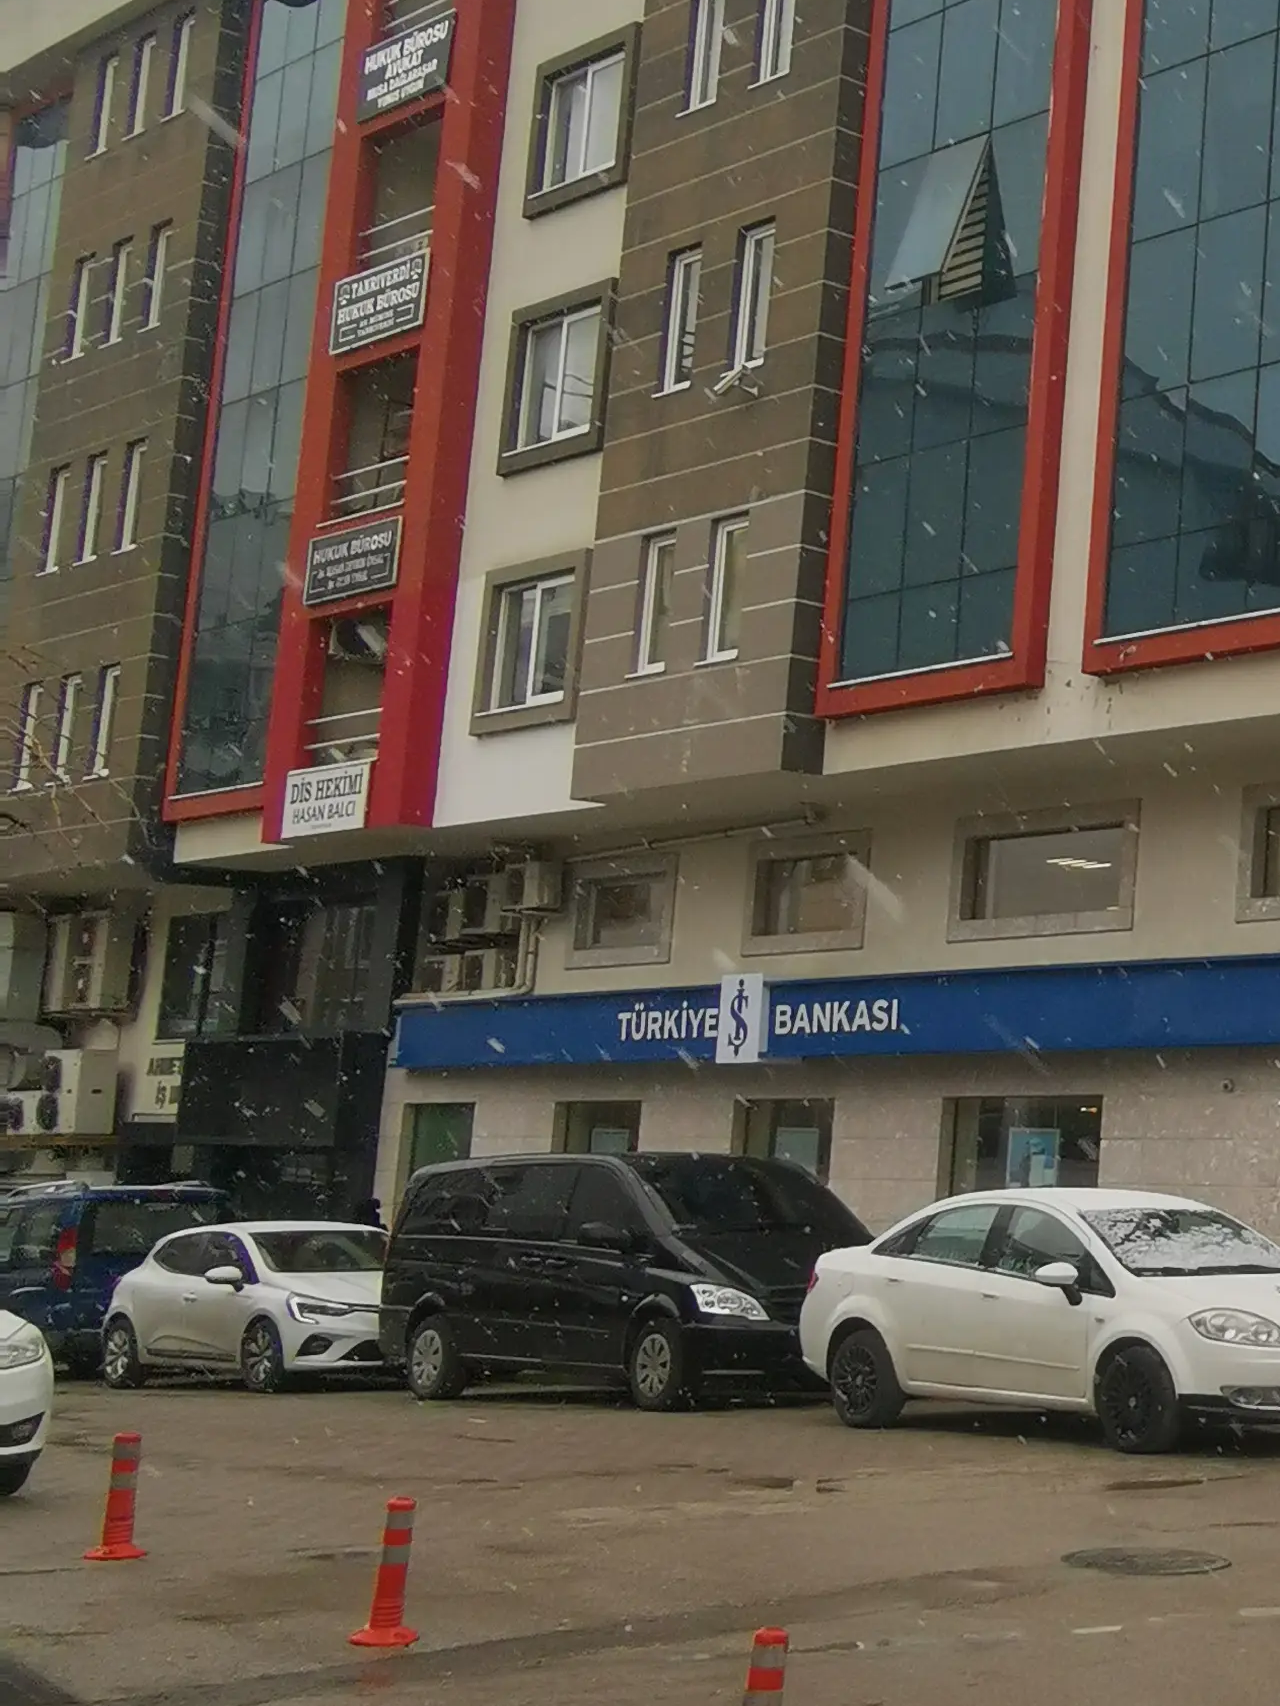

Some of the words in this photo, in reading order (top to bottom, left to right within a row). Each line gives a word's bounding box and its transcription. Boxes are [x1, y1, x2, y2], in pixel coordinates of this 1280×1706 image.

[403, 20, 449, 56] BÜROSU
[313, 541, 350, 566] HUKUK
[350, 530, 392, 555] BÜROSU
[315, 768, 364, 801] HEKİMİ
[292, 803, 326, 825] HASAN
[327, 800, 357, 820] BALCI
[617, 1000, 719, 1042] TÜRKİYE
[774, 998, 899, 1035] BANKASI
